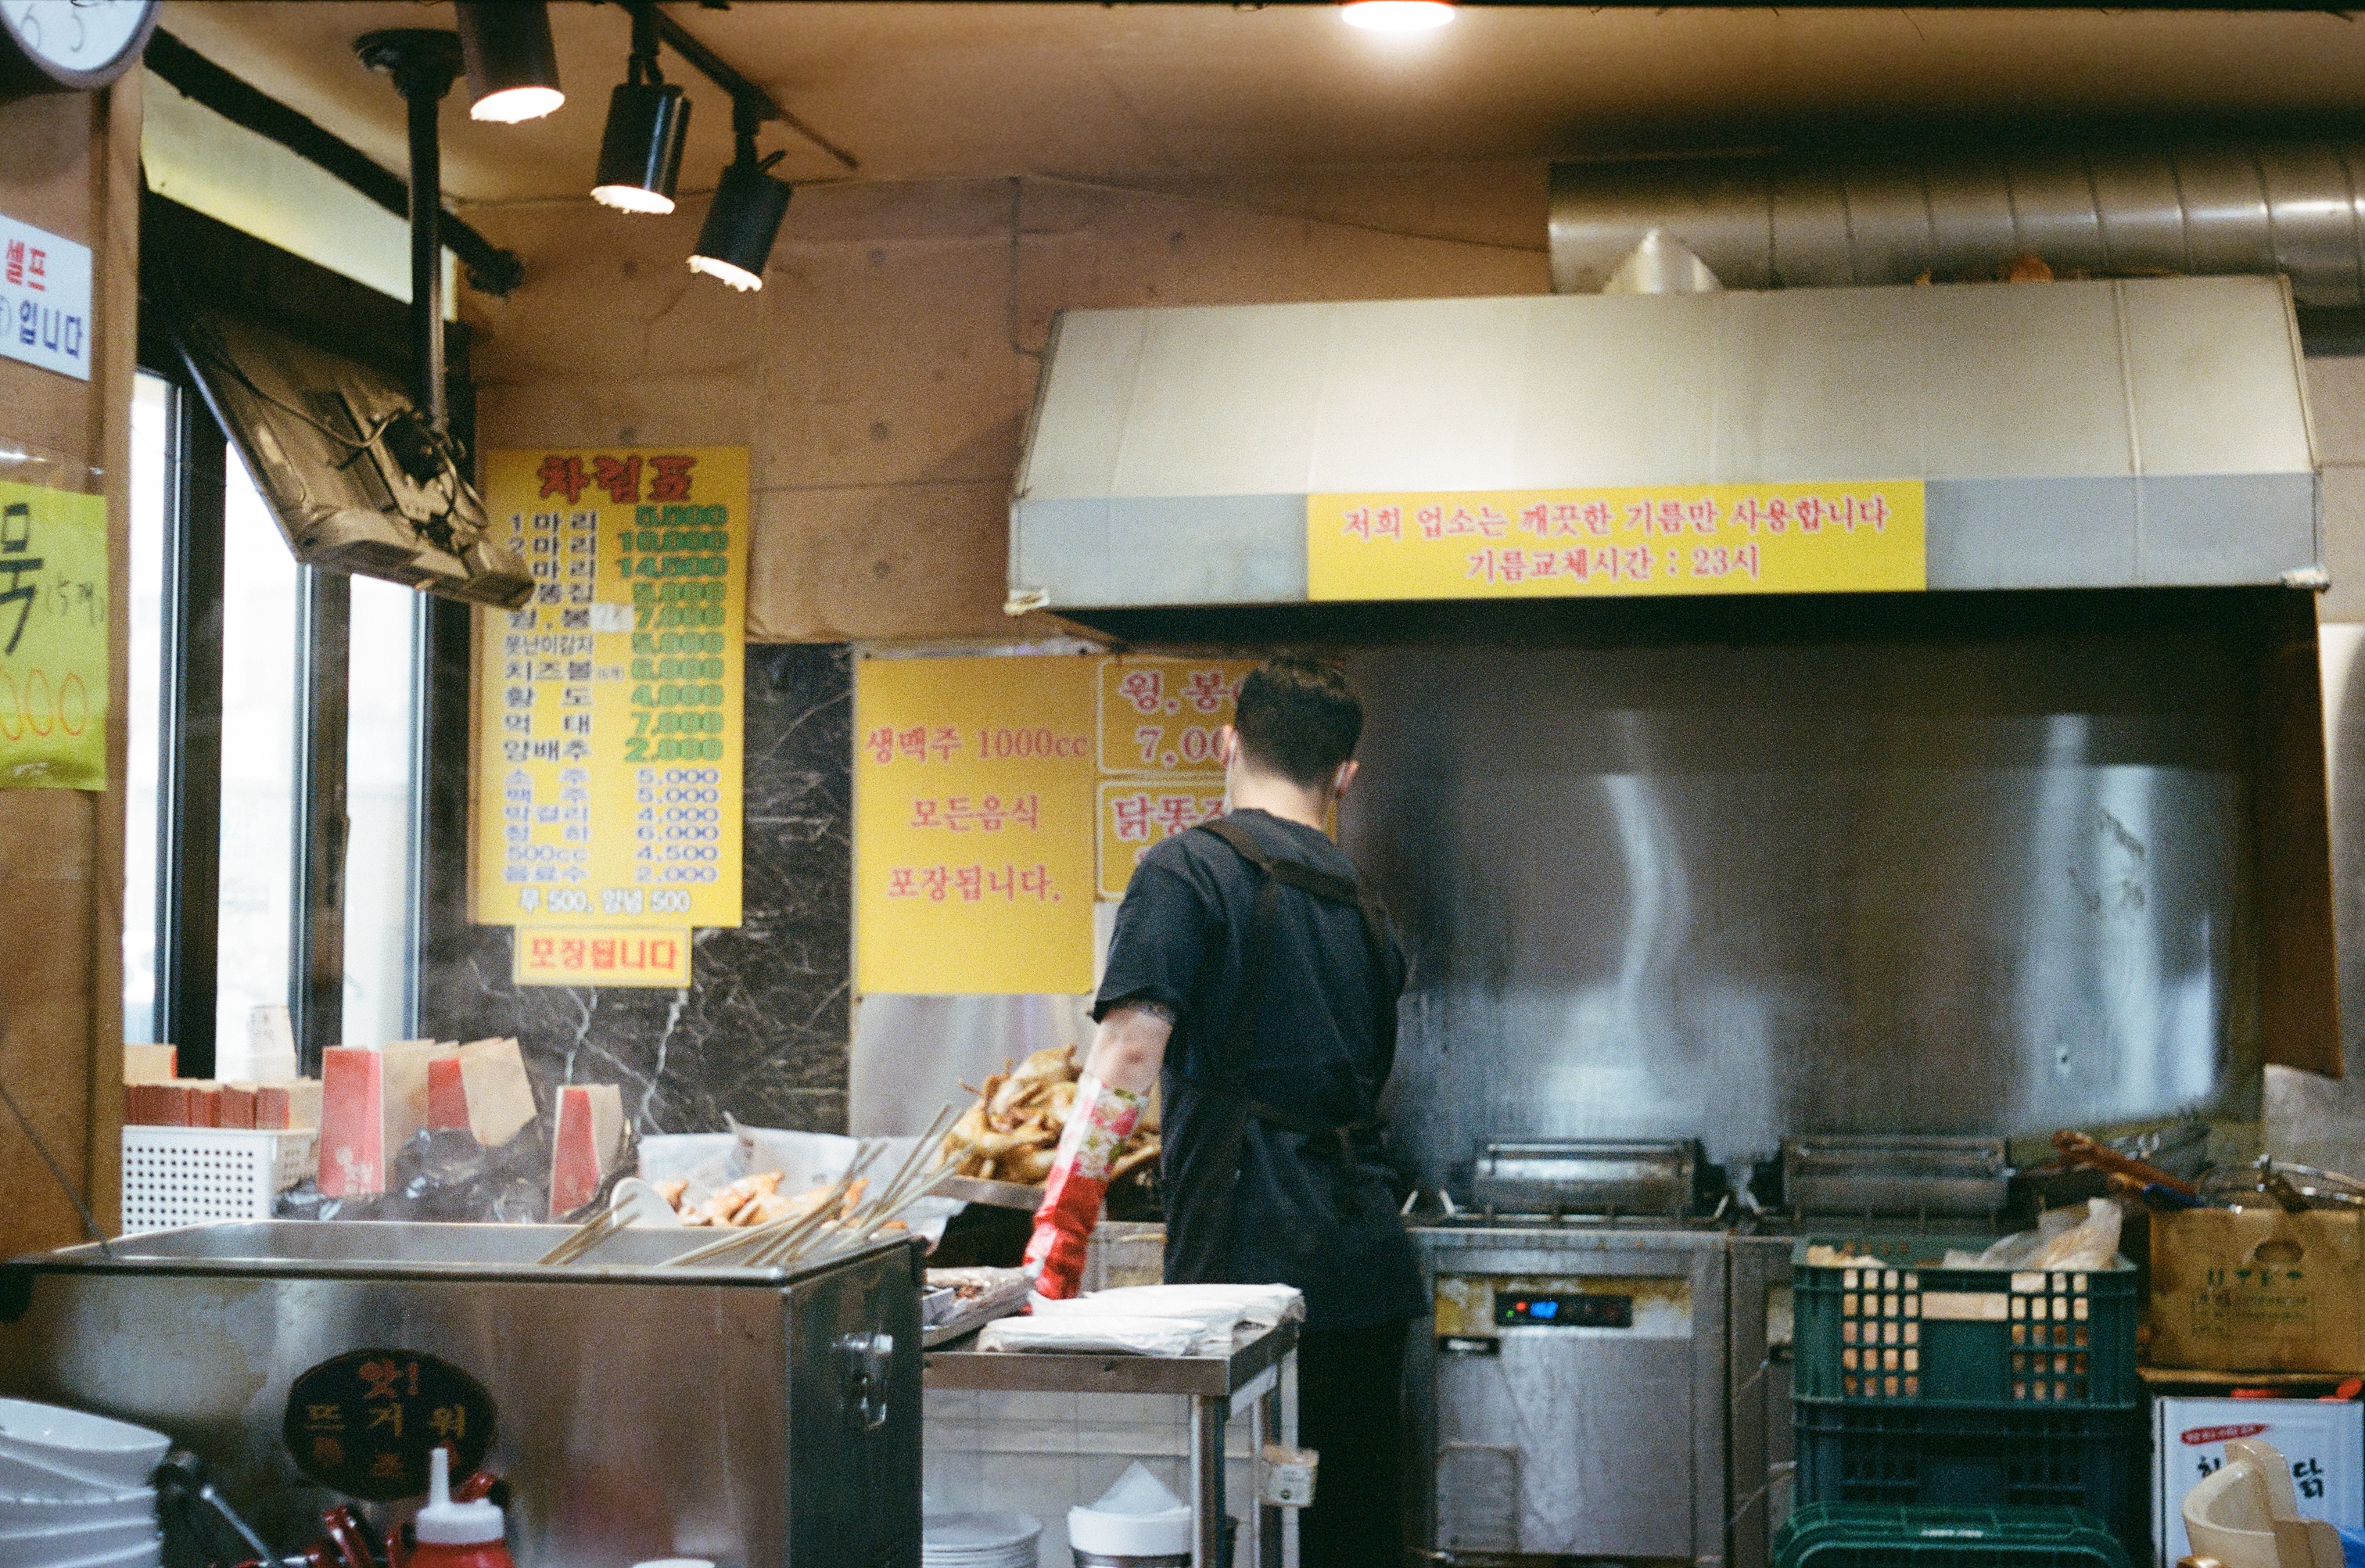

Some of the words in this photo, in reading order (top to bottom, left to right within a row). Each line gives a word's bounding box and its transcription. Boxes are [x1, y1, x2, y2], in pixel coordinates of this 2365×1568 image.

[537, 454, 696, 504] 차림표
[1343, 507, 1400, 541] 저희
[1417, 506, 1509, 539] 업소는
[1520, 501, 1613, 537] 깨끗한
[1624, 499, 1718, 536] 기름만
[1729, 494, 1889, 533] 사용합니다
[1120, 669, 1240, 714] 윙.봉
[864, 725, 964, 764] 생맥주
[977, 727, 1089, 759] 1000cc
[910, 795, 1039, 831] 모든음식
[529, 938, 678, 971] 포장됩니다
